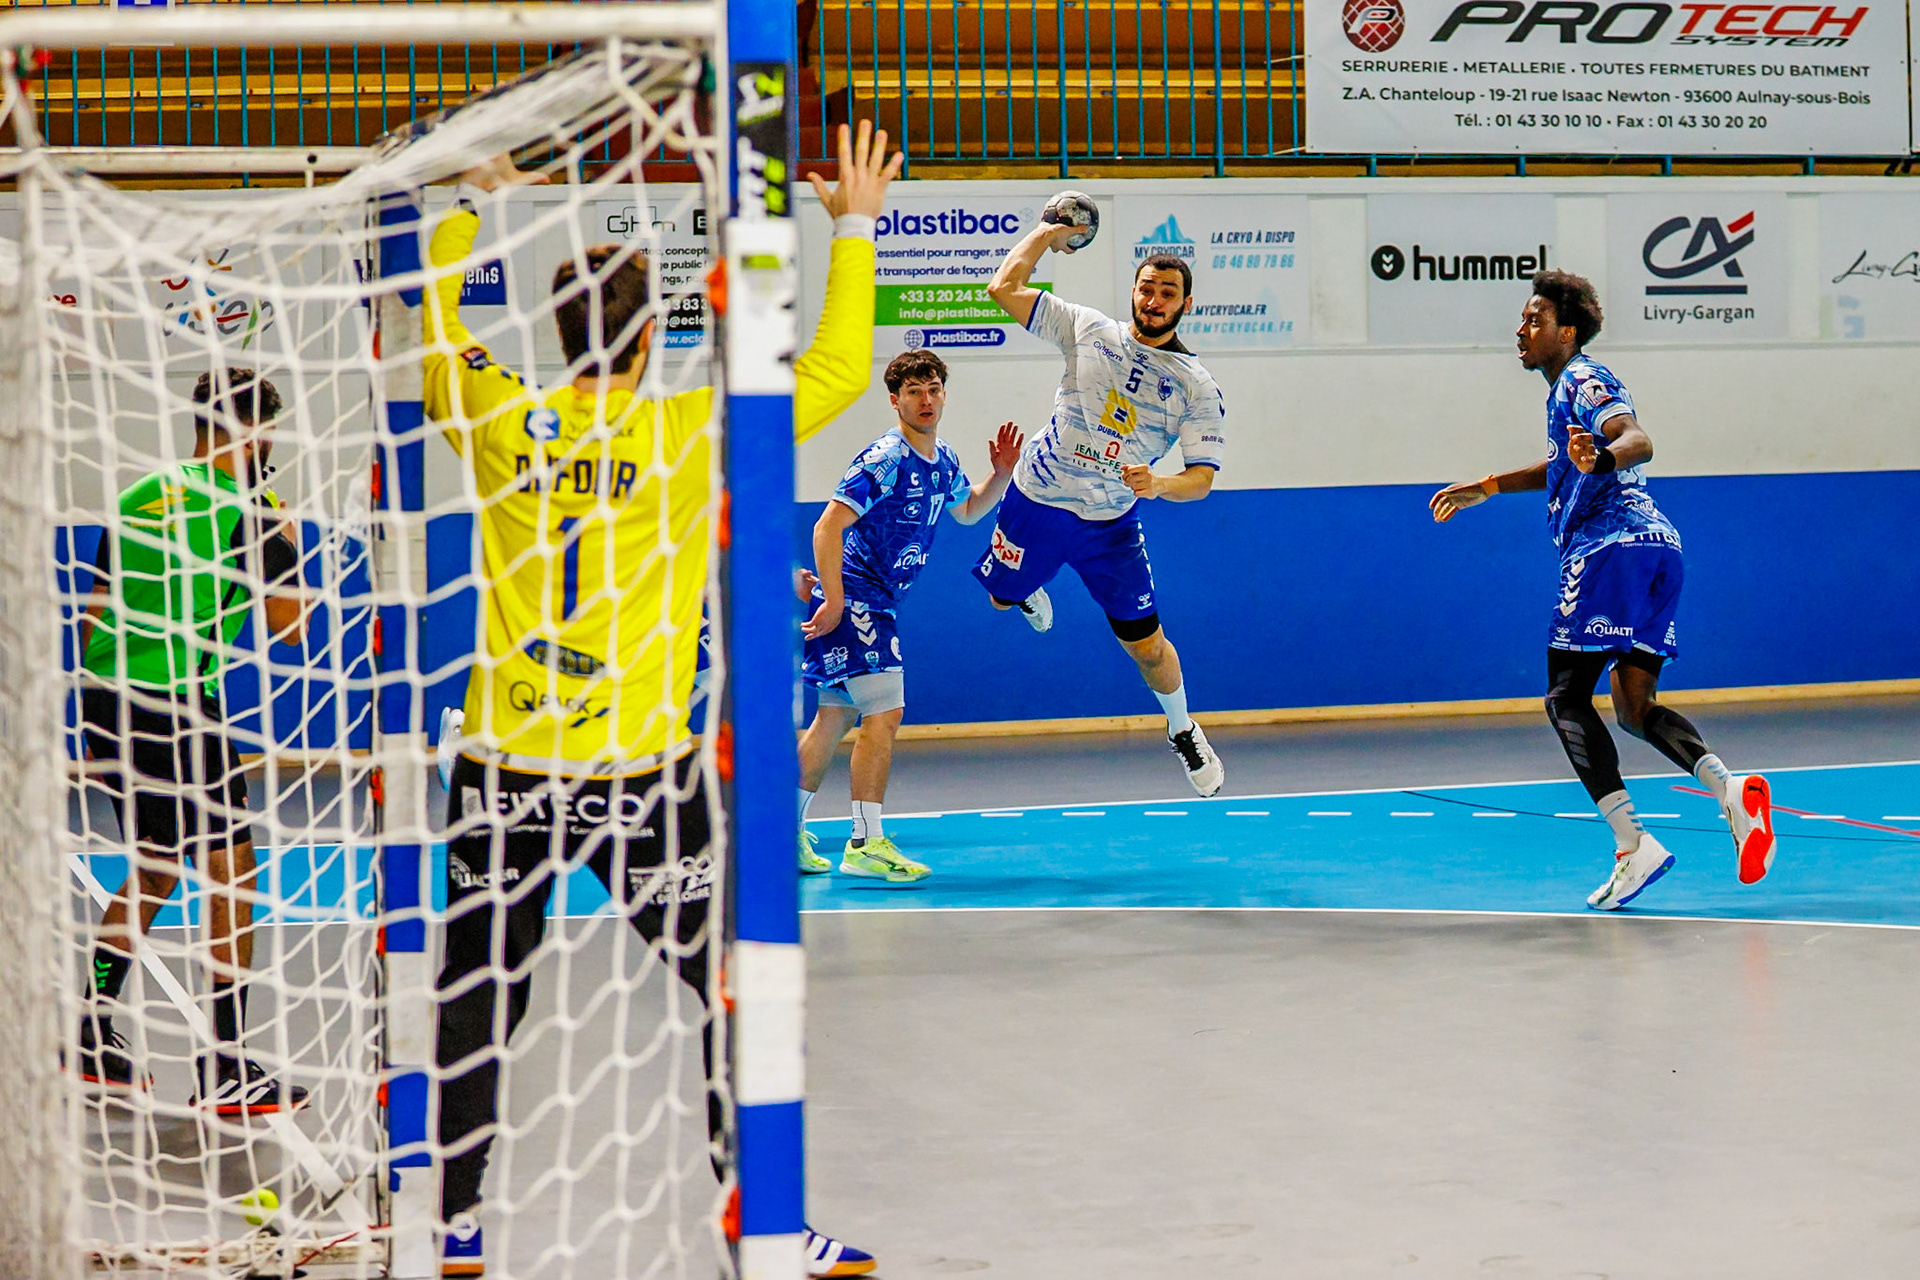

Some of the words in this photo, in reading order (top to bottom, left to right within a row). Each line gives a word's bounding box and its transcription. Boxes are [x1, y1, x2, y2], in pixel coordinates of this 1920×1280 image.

[1670, 35, 1850, 47] SYSTEM
[1342, 60, 1449, 73] SERRURERIE
[1463, 61, 1566, 74] METALLERIE
[1581, 62, 1645, 75] TOUTES
[1649, 63, 1757, 76] FERMETURES
[1762, 65, 1785, 76] DU
[1790, 65, 1870, 77] BATIMENT
[1342, 87, 1376, 100] Z.A.
[1380, 87, 1475, 104] Chanteloup
[1489, 88, 1527, 101] 19-21
[1532, 91, 1558, 102] rue
[1562, 89, 1603, 102] Isaac
[1607, 89, 1671, 103] Newton
[1683, 90, 1733, 104] 93600
[1737, 91, 1872, 106] Aulnay-sous-Bois
[1454, 113, 1483, 127] Tél.
[1495, 115, 1512, 127] 01
[1517, 115, 1536, 127] 43
[1541, 115, 1560, 128] 30
[1564, 115, 1581, 127] 10
[1586, 115, 1601, 127] 10
[1617, 115, 1645, 128] Fax
[1657, 115, 1674, 128] 01
[1678, 116, 1697, 128] 43
[1701, 116, 1720, 128] 30
[1724, 116, 1744, 128] 20
[1749, 116, 1768, 128] 20
[874, 208, 1020, 242] plastibac
[1211, 231, 1224, 244] LA
[1226, 231, 1252, 244] CRYO
[1265, 231, 1296, 244] DISPO
[926, 249, 952, 260] pour
[1134, 246, 1150, 259] MY
[670, 259, 703, 272] public
[1412, 243, 1547, 282] hummel
[883, 266, 945, 278] transporter
[947, 266, 961, 275] de
[962, 265, 994, 277] façon
[899, 290, 924, 303] +33
[926, 291, 935, 302] 3
[936, 290, 954, 302] 20
[955, 290, 973, 302] 24
[1643, 304, 1755, 325] Livry-Gargan
[929, 331, 1000, 346] plastibac.fr
[1124, 367, 1144, 394] 5
[926, 492, 945, 527] 17
[556, 516, 583, 621] 1
[980, 553, 994, 578] 5
[1584, 623, 1634, 638] AQUALTI
